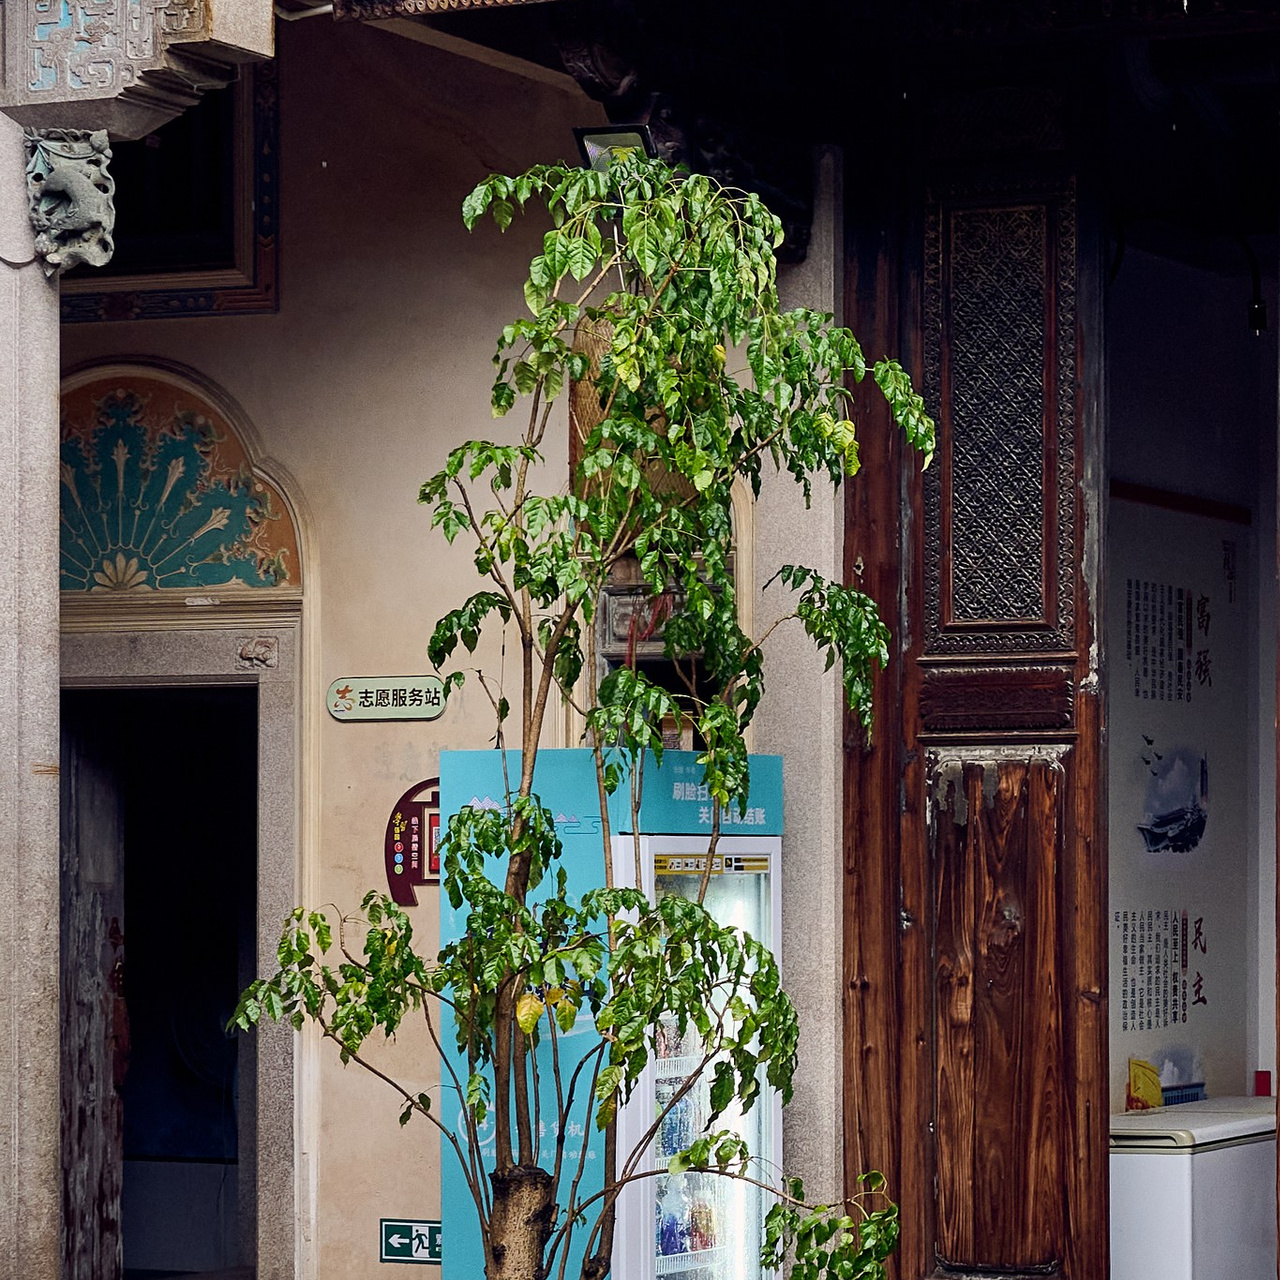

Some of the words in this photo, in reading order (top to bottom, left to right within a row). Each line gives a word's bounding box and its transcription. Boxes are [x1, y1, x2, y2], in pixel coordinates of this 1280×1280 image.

[358, 687, 441, 708] 志愿服务站
[1191, 917, 1208, 1005] 民主
